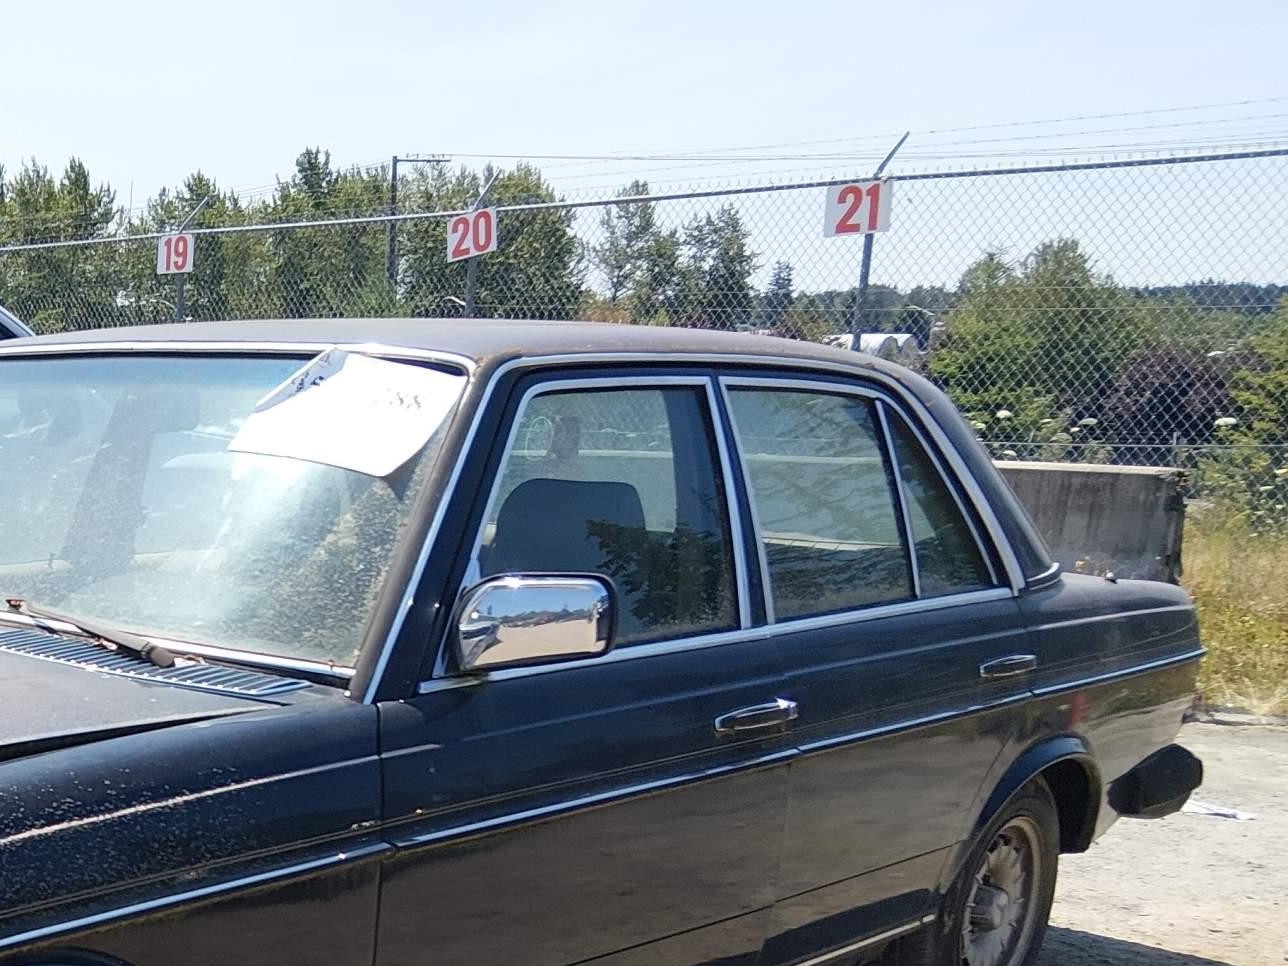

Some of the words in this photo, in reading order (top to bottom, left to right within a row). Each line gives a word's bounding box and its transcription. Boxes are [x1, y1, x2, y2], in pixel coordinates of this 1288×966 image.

[834, 183, 881, 235] 21
[164, 236, 188, 273] 19
[451, 210, 492, 259] 20
